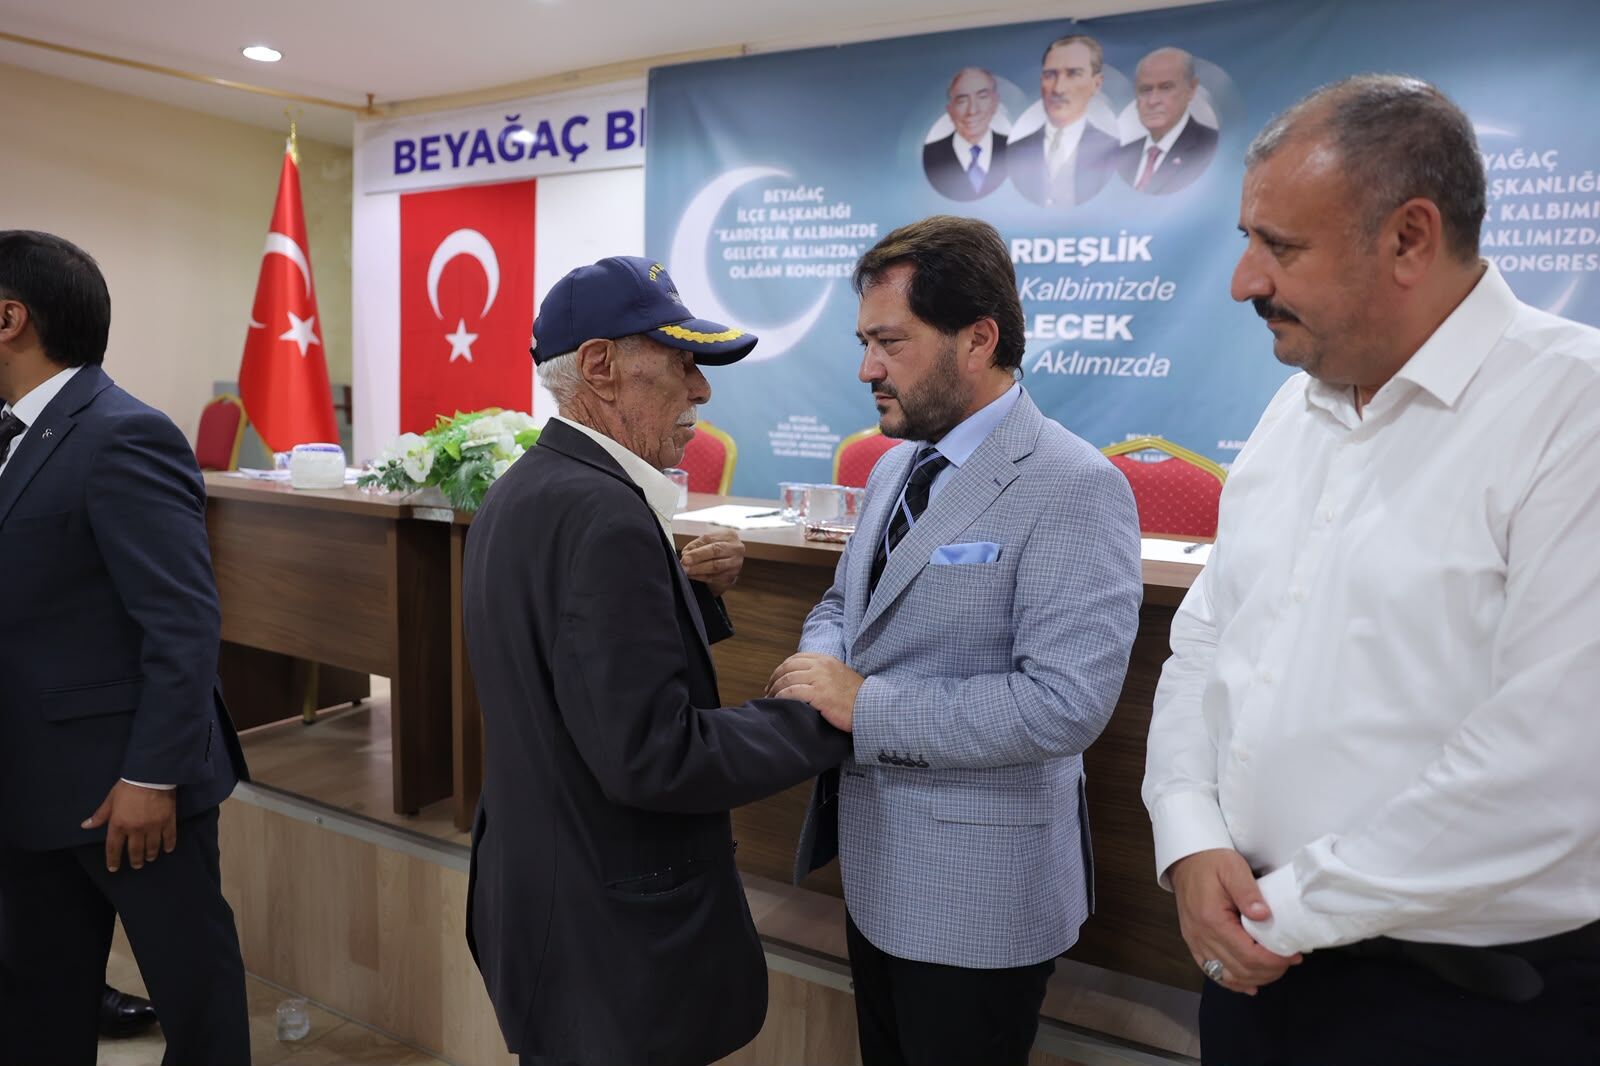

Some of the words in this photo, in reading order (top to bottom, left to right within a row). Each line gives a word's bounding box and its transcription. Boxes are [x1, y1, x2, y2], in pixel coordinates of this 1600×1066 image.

[394, 113, 589, 175] BEYAĞAÇ
[1482, 148, 1558, 173] YAĞAÇ
[763, 184, 825, 204] BEYAĞAÇ
[737, 205, 766, 223] İLÇE
[769, 203, 851, 224] BAŞKANLIĞI
[1010, 229, 1152, 267] RDEŞLİK
[1480, 227, 1600, 247] AKLIMIZD
[722, 246, 779, 261] GELECEK
[729, 262, 782, 279] OLAĞAN
[1019, 275, 1176, 301] Kalbimizde
[1032, 350, 1171, 378] Aklımızda
